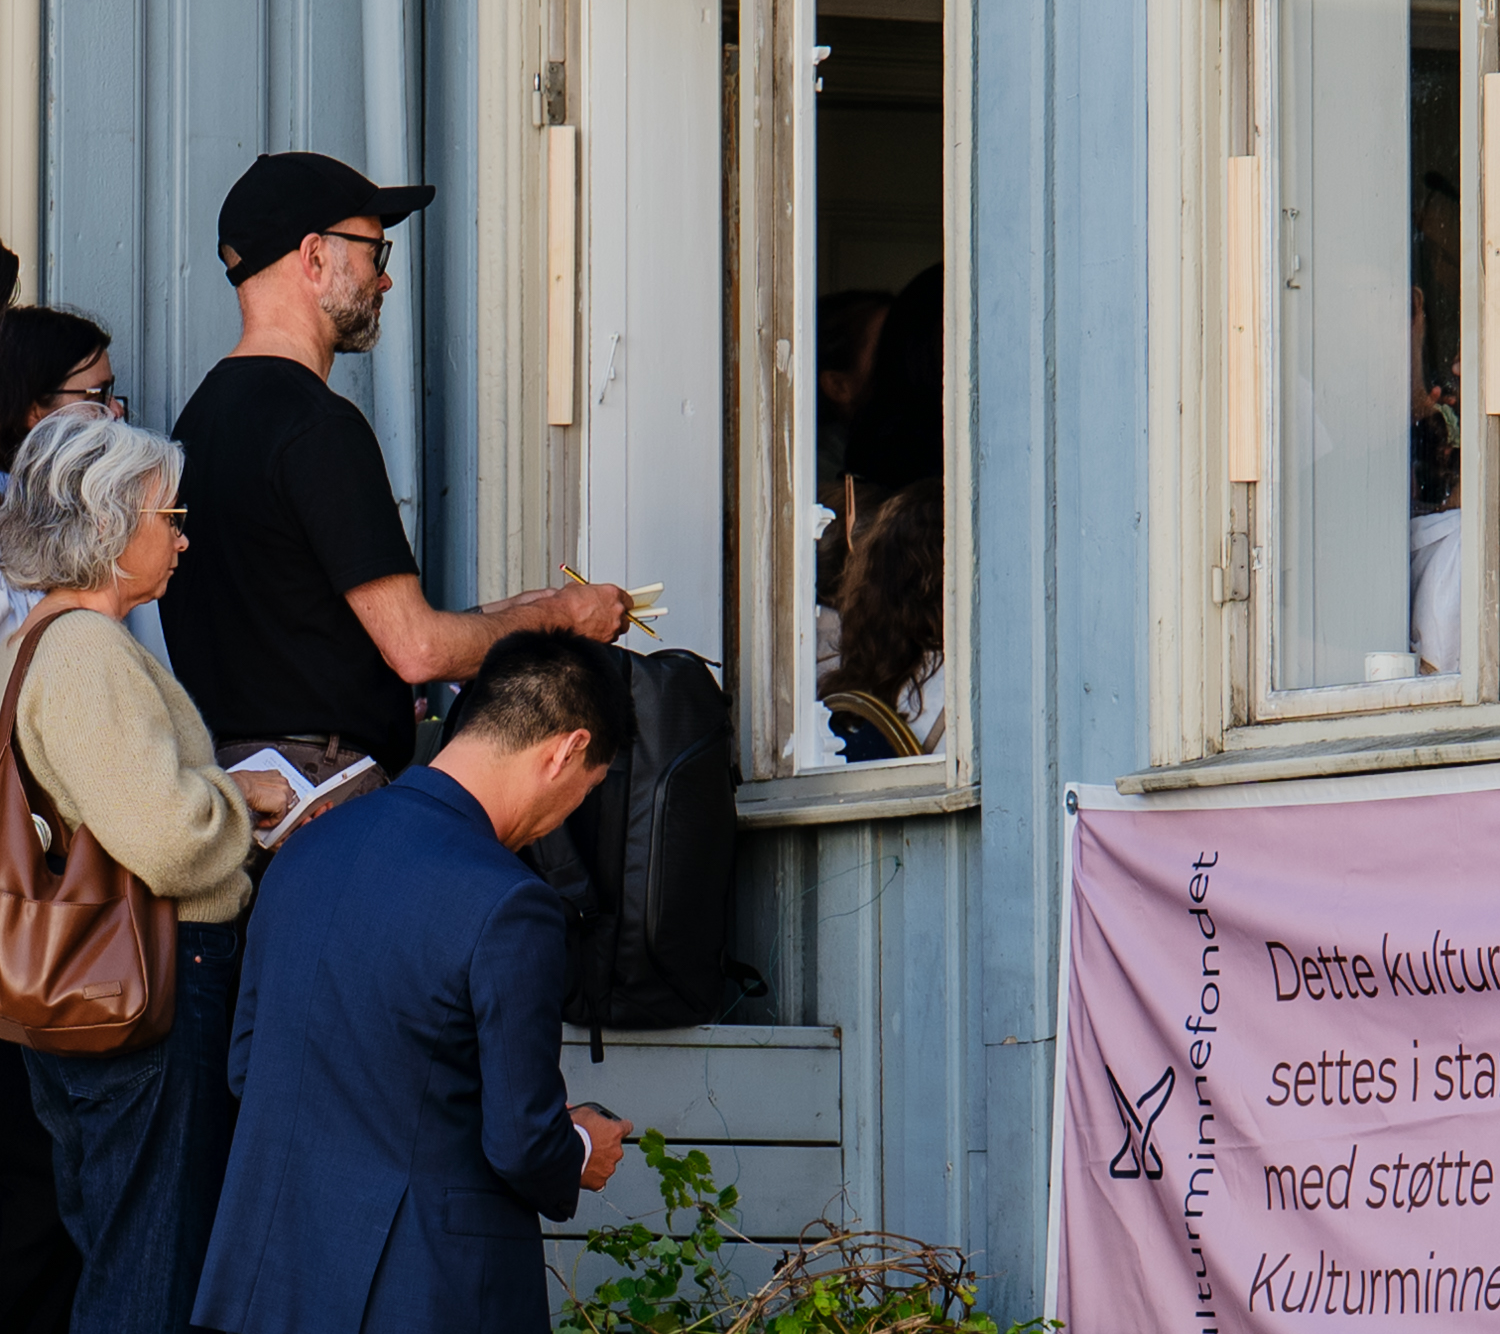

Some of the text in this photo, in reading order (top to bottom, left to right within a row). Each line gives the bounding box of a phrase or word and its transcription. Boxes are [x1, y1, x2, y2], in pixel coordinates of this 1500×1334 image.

[1265, 939, 1380, 1003] Dette
[1265, 1046, 1398, 1108] settes
[1410, 1040, 1421, 1103] i
[1263, 1145, 1360, 1210] med
[1364, 1148, 1493, 1217] støtte
